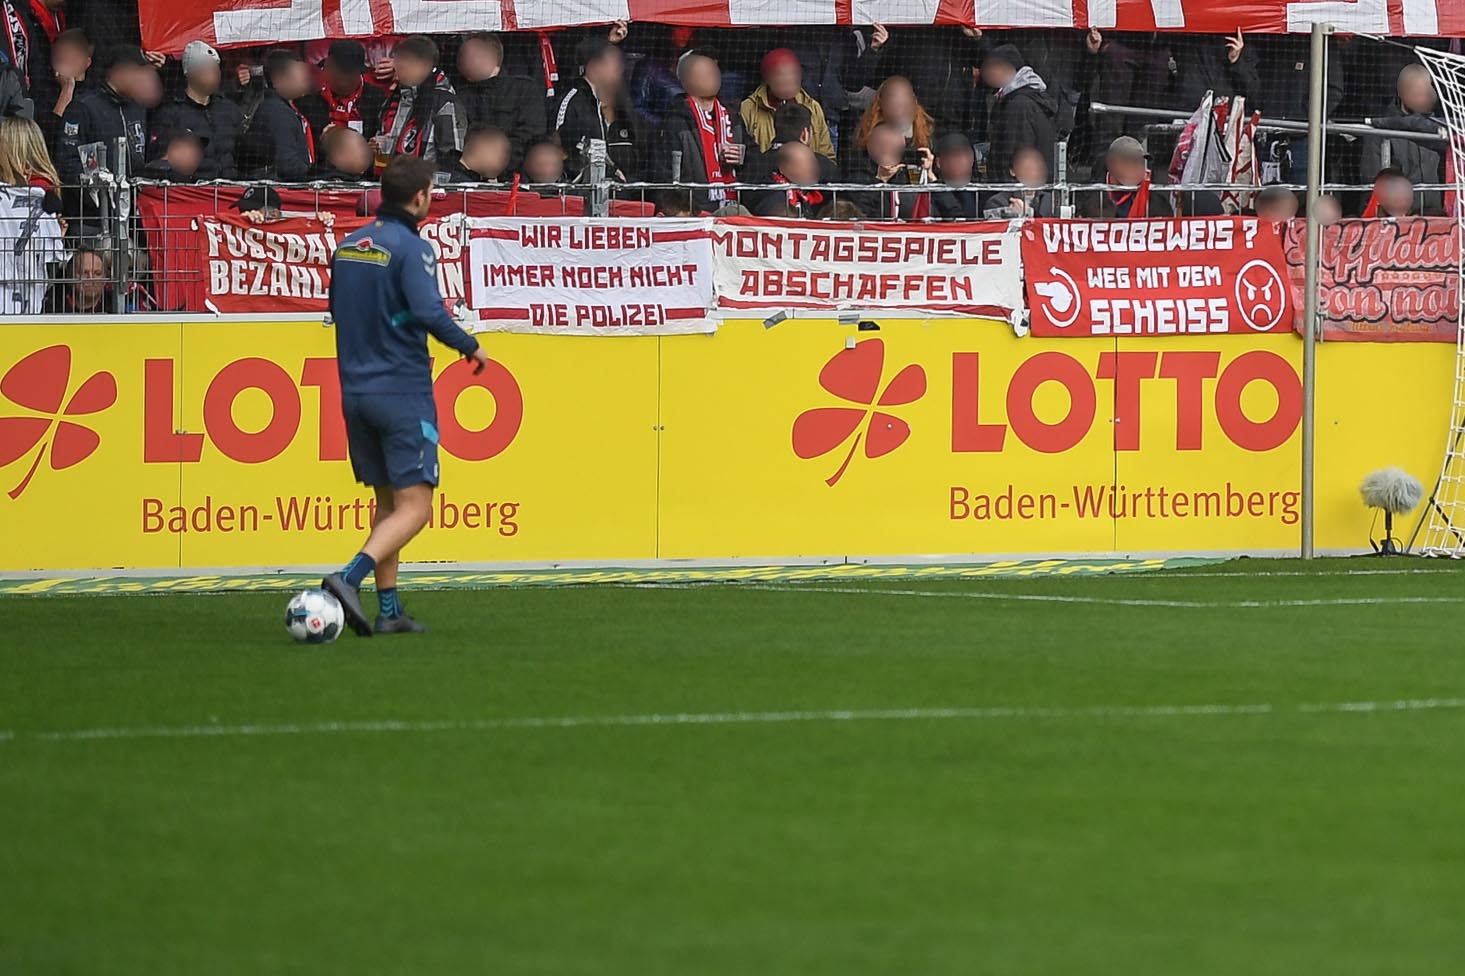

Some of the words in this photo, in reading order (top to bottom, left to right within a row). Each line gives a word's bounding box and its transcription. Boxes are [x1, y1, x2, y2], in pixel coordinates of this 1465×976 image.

[521, 225, 563, 249] WIR
[569, 226, 651, 250] LIEBEN
[710, 230, 1003, 265] MONTAGSSPIELE
[483, 264, 555, 288] IMMER
[561, 266, 625, 289] NOCH
[630, 264, 698, 288] NICHT
[739, 270, 974, 301] ABSCHAFFEN
[1087, 267, 1130, 289] WEG
[1136, 267, 1171, 289] MIT
[1176, 265, 1222, 288] DEM
[529, 303, 570, 327] DIE
[575, 303, 665, 328] POLIZEI
[1089, 297, 1229, 334] SCHEISS
[144, 356, 524, 464] LOTO
[951, 350, 1304, 454] LOTTO
[142, 493, 521, 537] Baden-Württberg
[949, 482, 1301, 525] Baden-Württemberg
